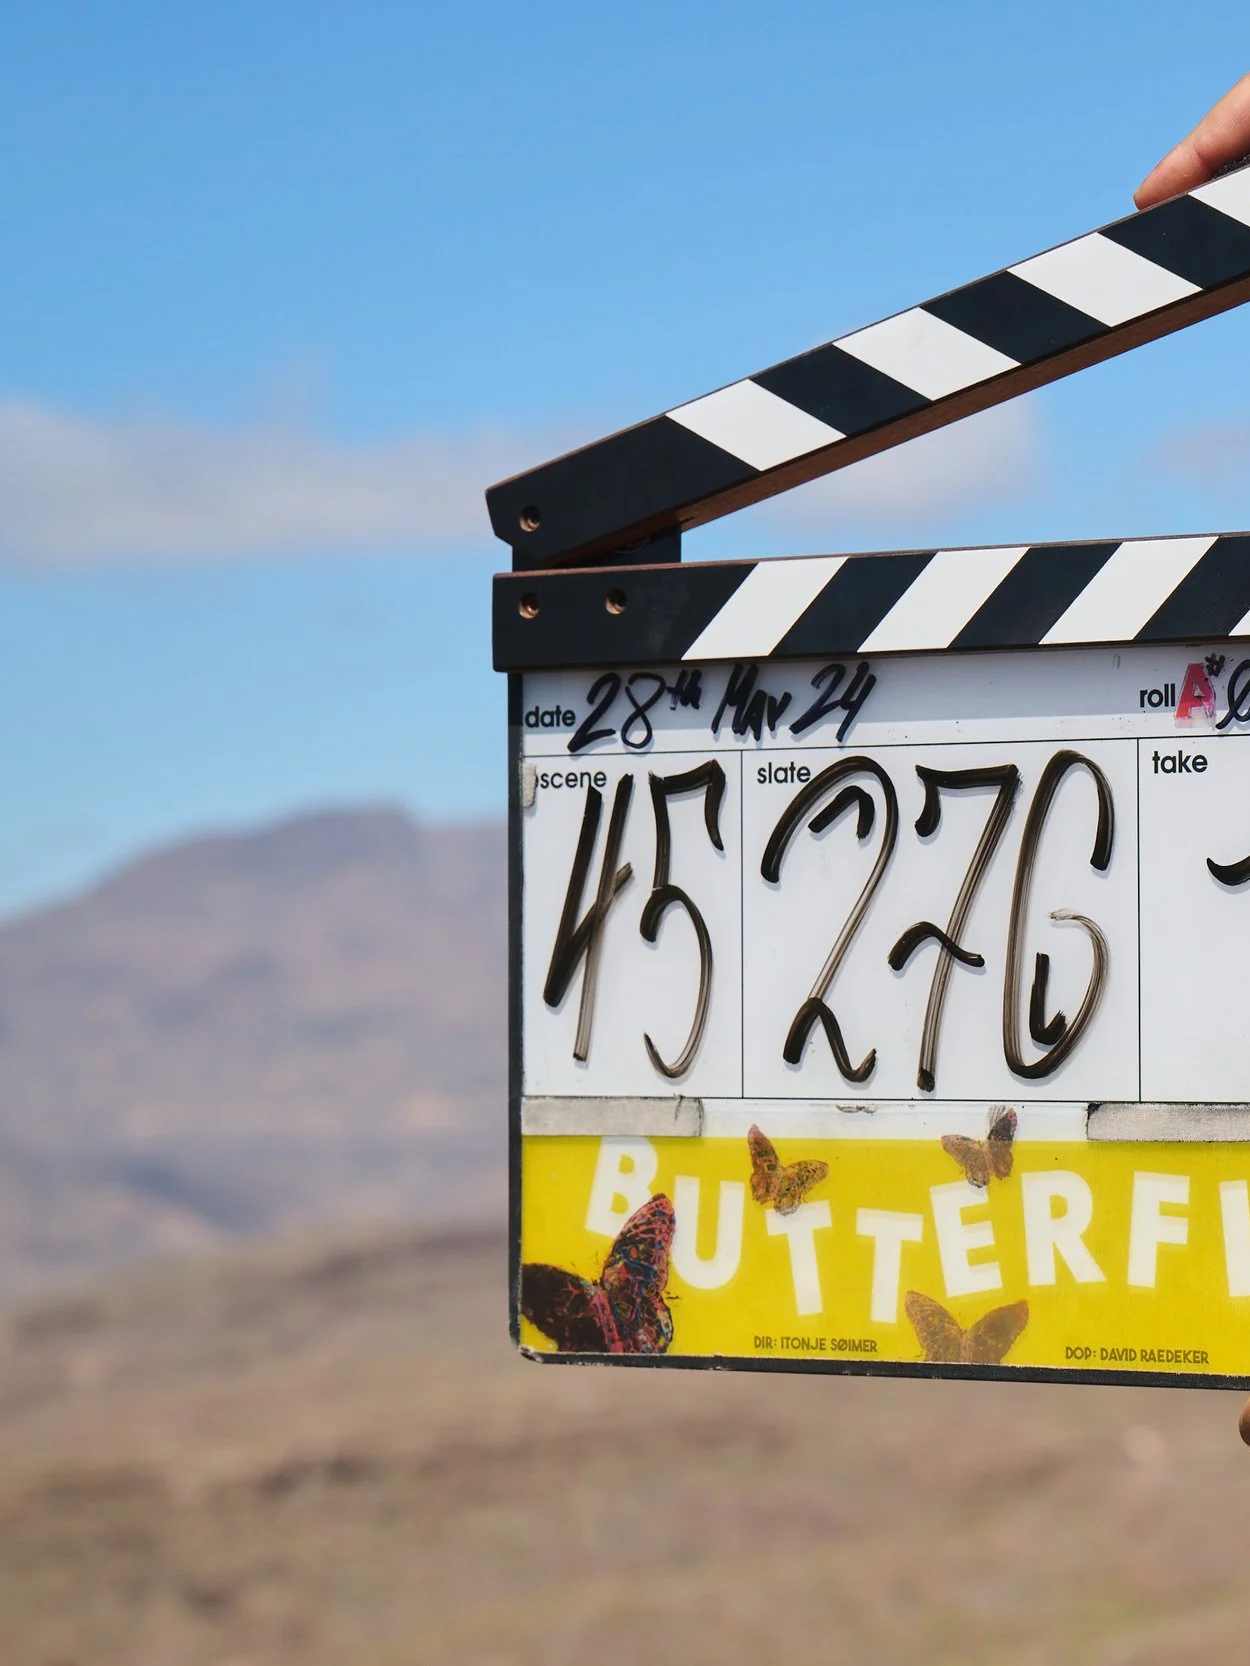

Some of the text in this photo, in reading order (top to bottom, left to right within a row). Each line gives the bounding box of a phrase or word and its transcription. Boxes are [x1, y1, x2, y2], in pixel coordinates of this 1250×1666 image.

[788, 660, 877, 742] 24
[1139, 683, 1176, 708] roll
[525, 704, 577, 728] date
[757, 762, 812, 785] slate
[1152, 750, 1209, 775] take
[542, 758, 727, 1080] 45
[760, 748, 1116, 1092] 276
[754, 1335, 778, 1349] DIR:
[780, 1335, 827, 1351] ITONJE
[1065, 1346, 1209, 1364] DOP: DAVID RAEDEKER
